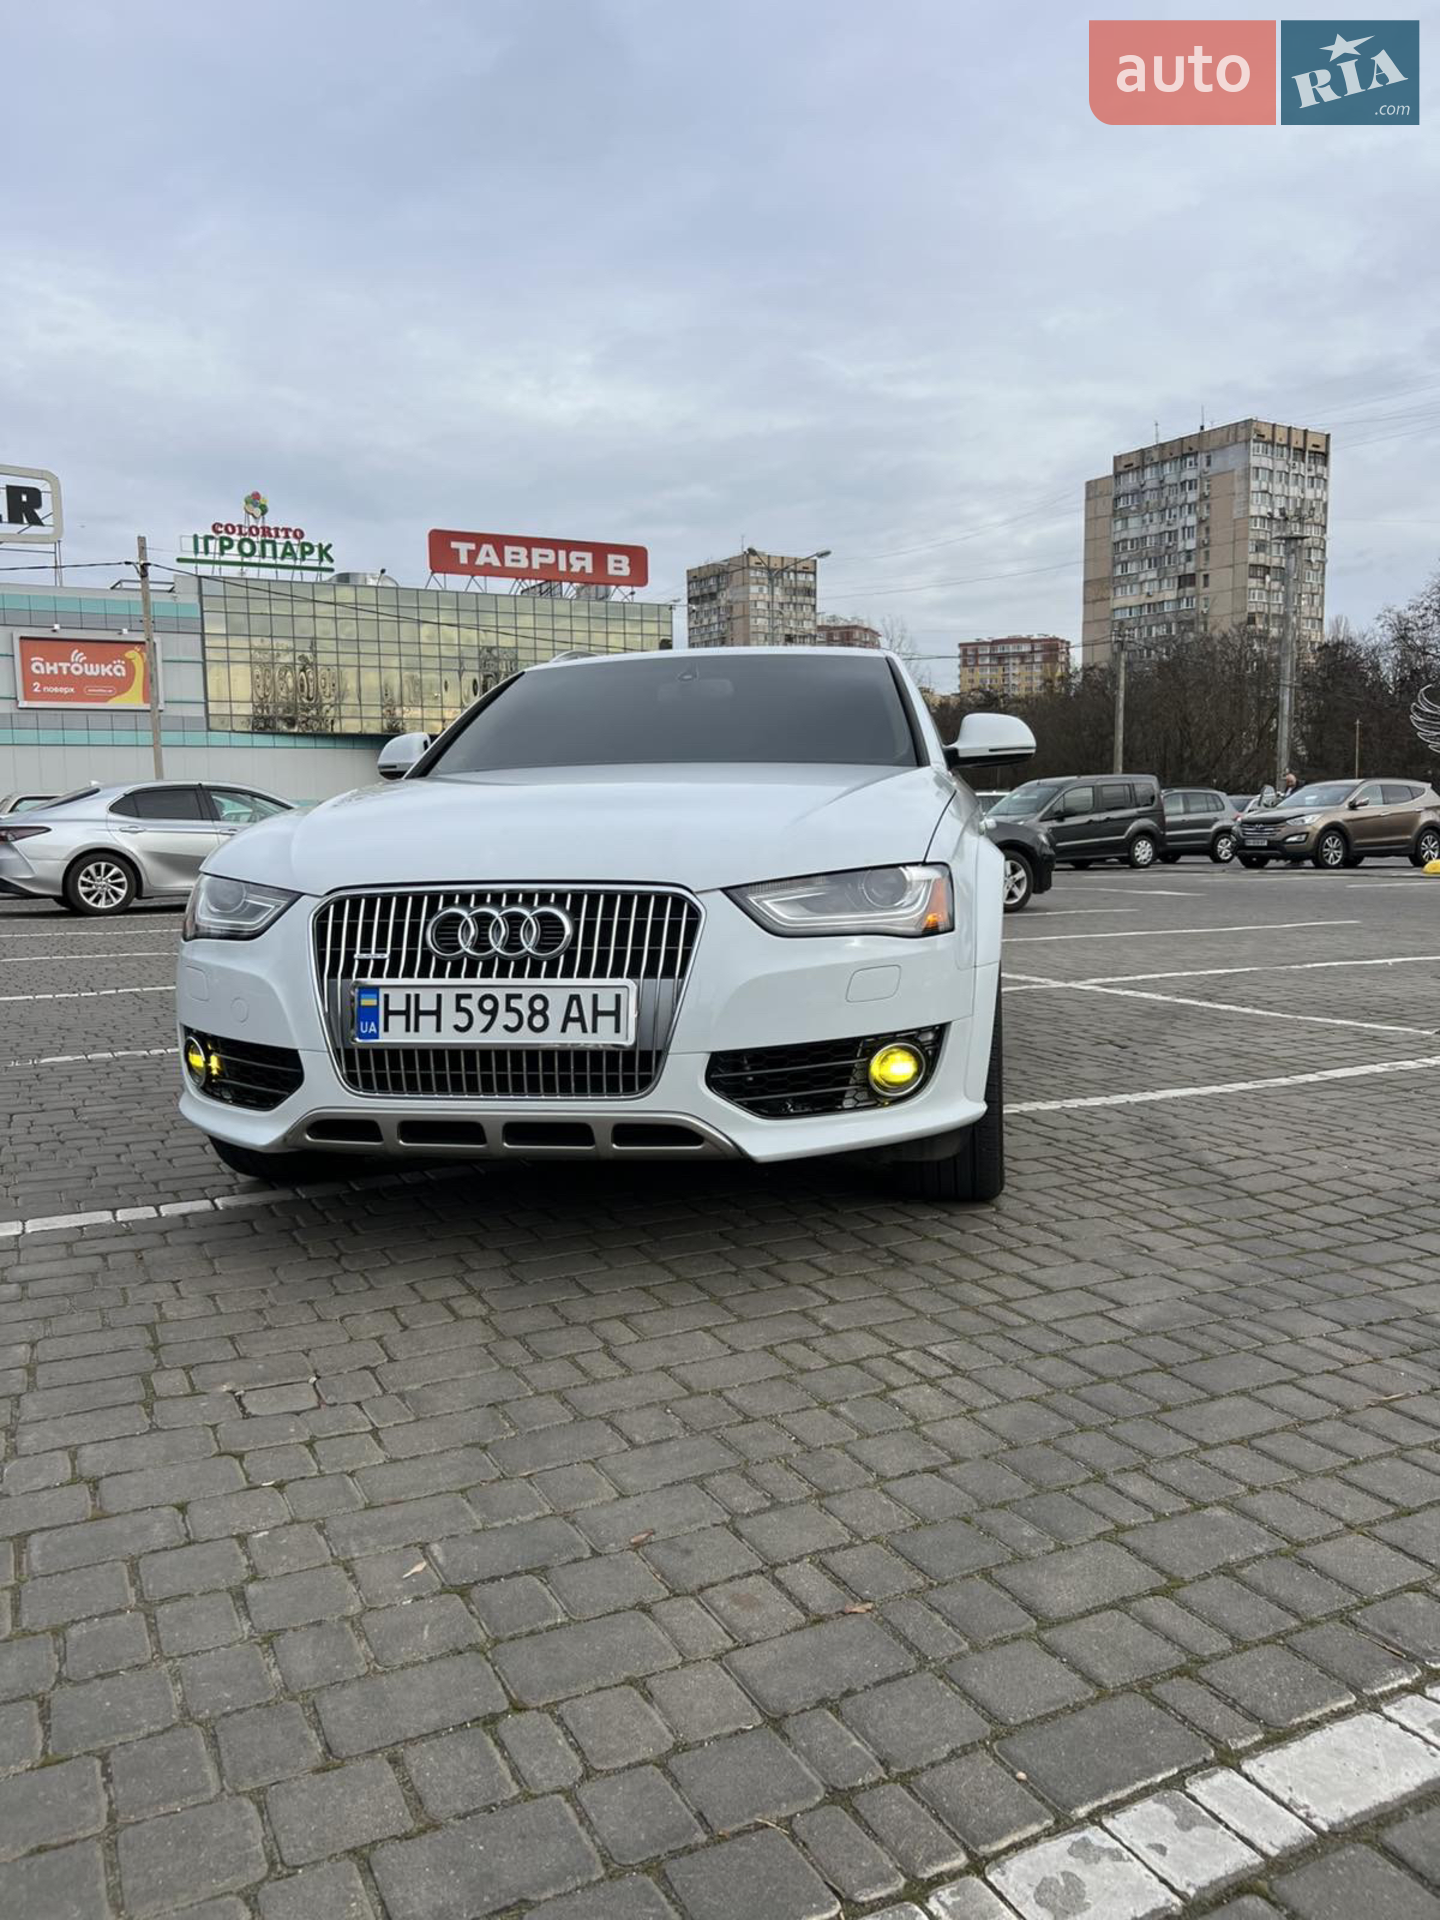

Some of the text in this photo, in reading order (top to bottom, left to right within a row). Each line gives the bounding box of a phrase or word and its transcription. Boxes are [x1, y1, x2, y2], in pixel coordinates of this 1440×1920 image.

[0, 484, 45, 527] R
[211, 521, 305, 540] COLORITO
[192, 533, 335, 563] ІГРОПАРК
[450, 540, 631, 577] ТАВРІЯ В
[30, 654, 127, 677] антошка
[32, 681, 41, 692] 2
[383, 993, 622, 1034] HH 5958 AH
[359, 1021, 378, 1034] UA
